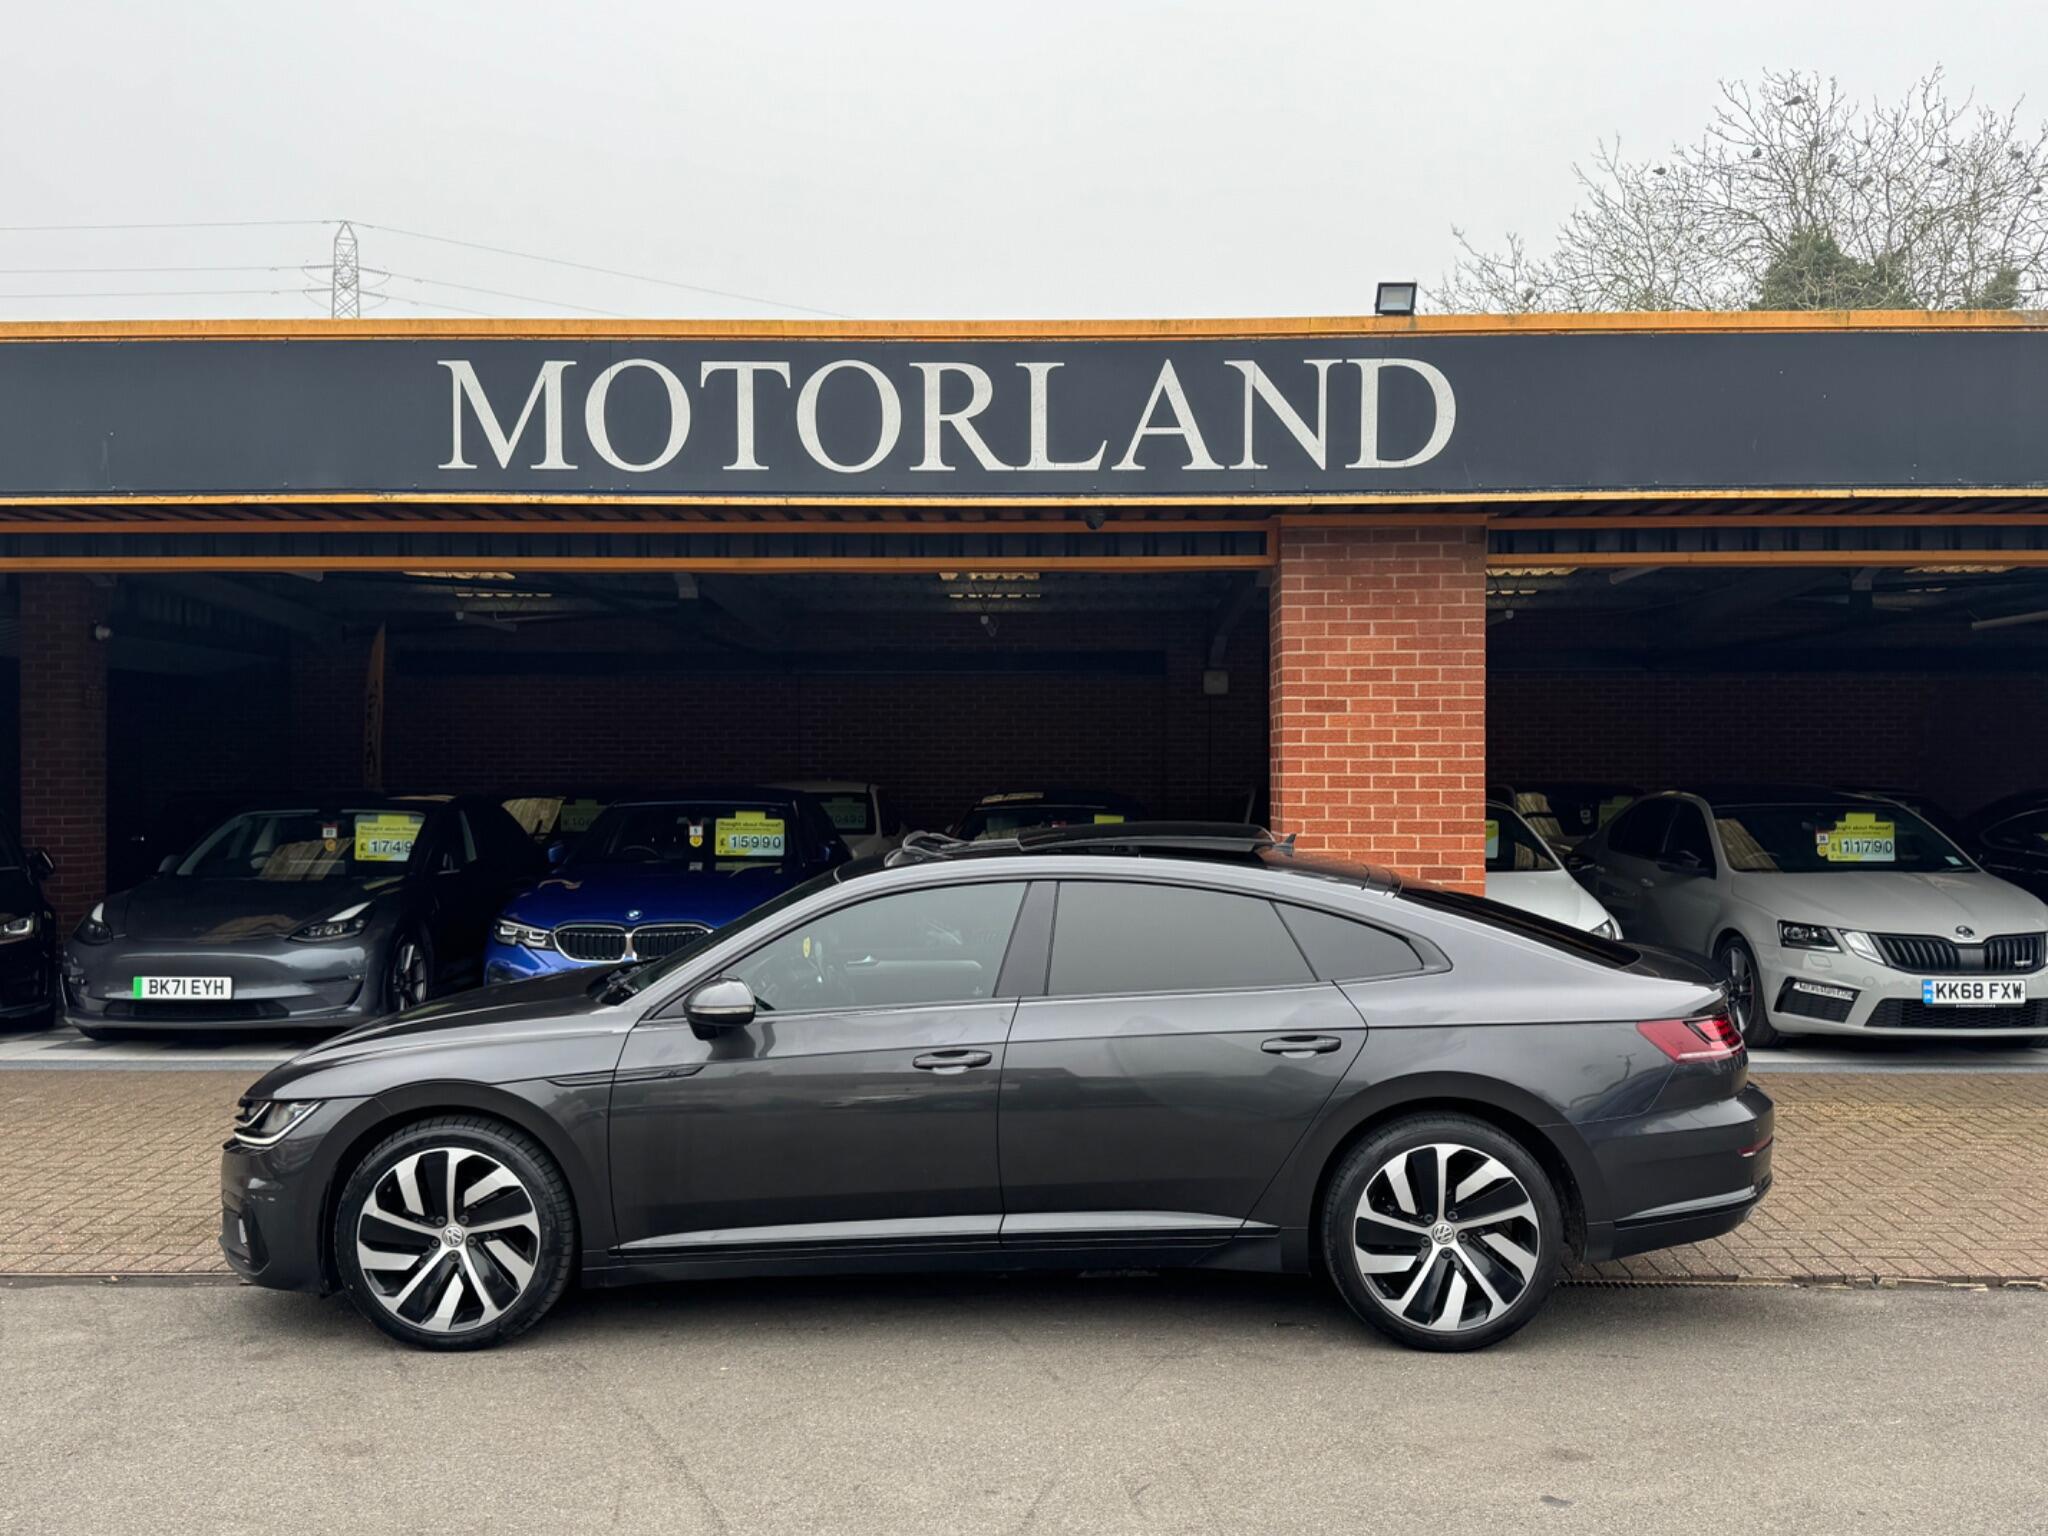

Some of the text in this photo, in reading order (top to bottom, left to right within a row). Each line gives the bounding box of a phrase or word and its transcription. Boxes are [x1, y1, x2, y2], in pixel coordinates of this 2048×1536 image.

[436, 357, 1458, 473] MOTORLAND
[731, 836, 781, 848] 15990
[1843, 840, 1893, 853] 11790
[148, 979, 224, 995] BK71 EYH
[1935, 982, 2022, 999] KK68 FXW
